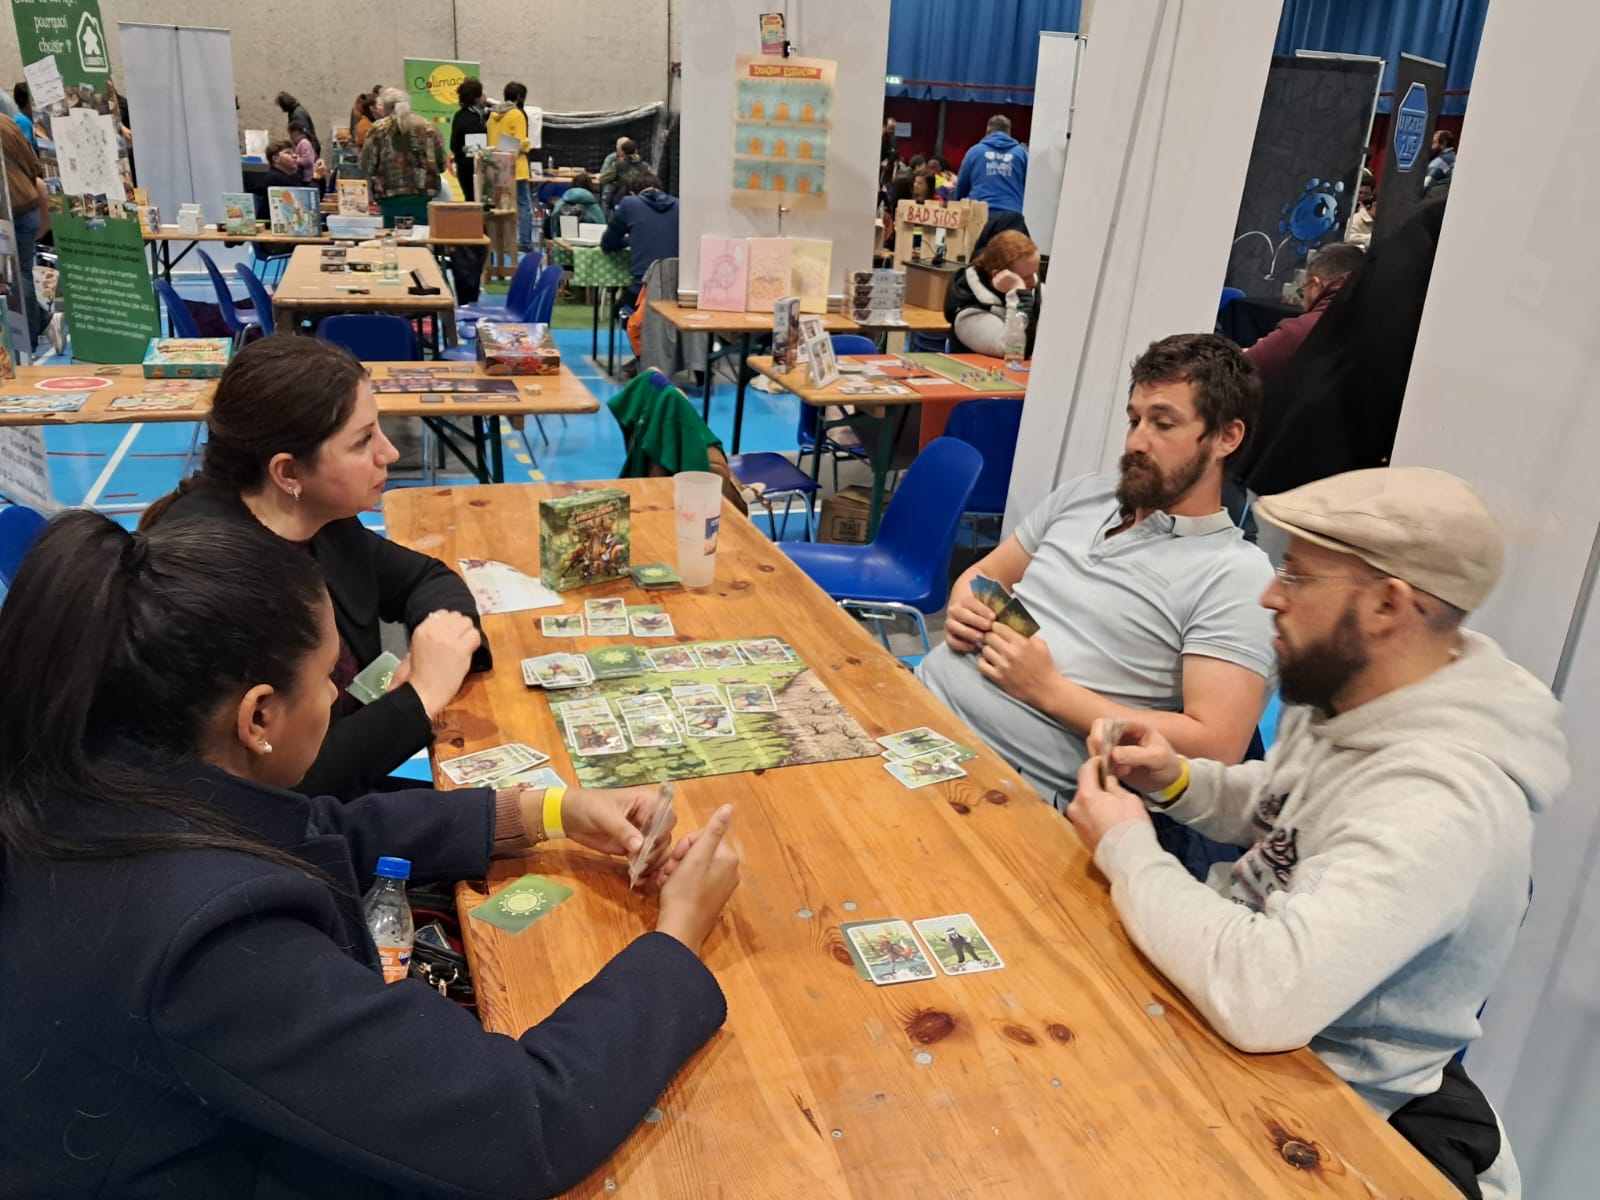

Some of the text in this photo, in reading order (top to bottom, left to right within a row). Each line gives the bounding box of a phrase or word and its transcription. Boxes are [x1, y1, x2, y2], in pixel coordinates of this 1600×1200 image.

[34, 15, 68, 34] pourquoi
[38, 37, 72, 53] choisir ?
[907, 206, 930, 222] BAD
